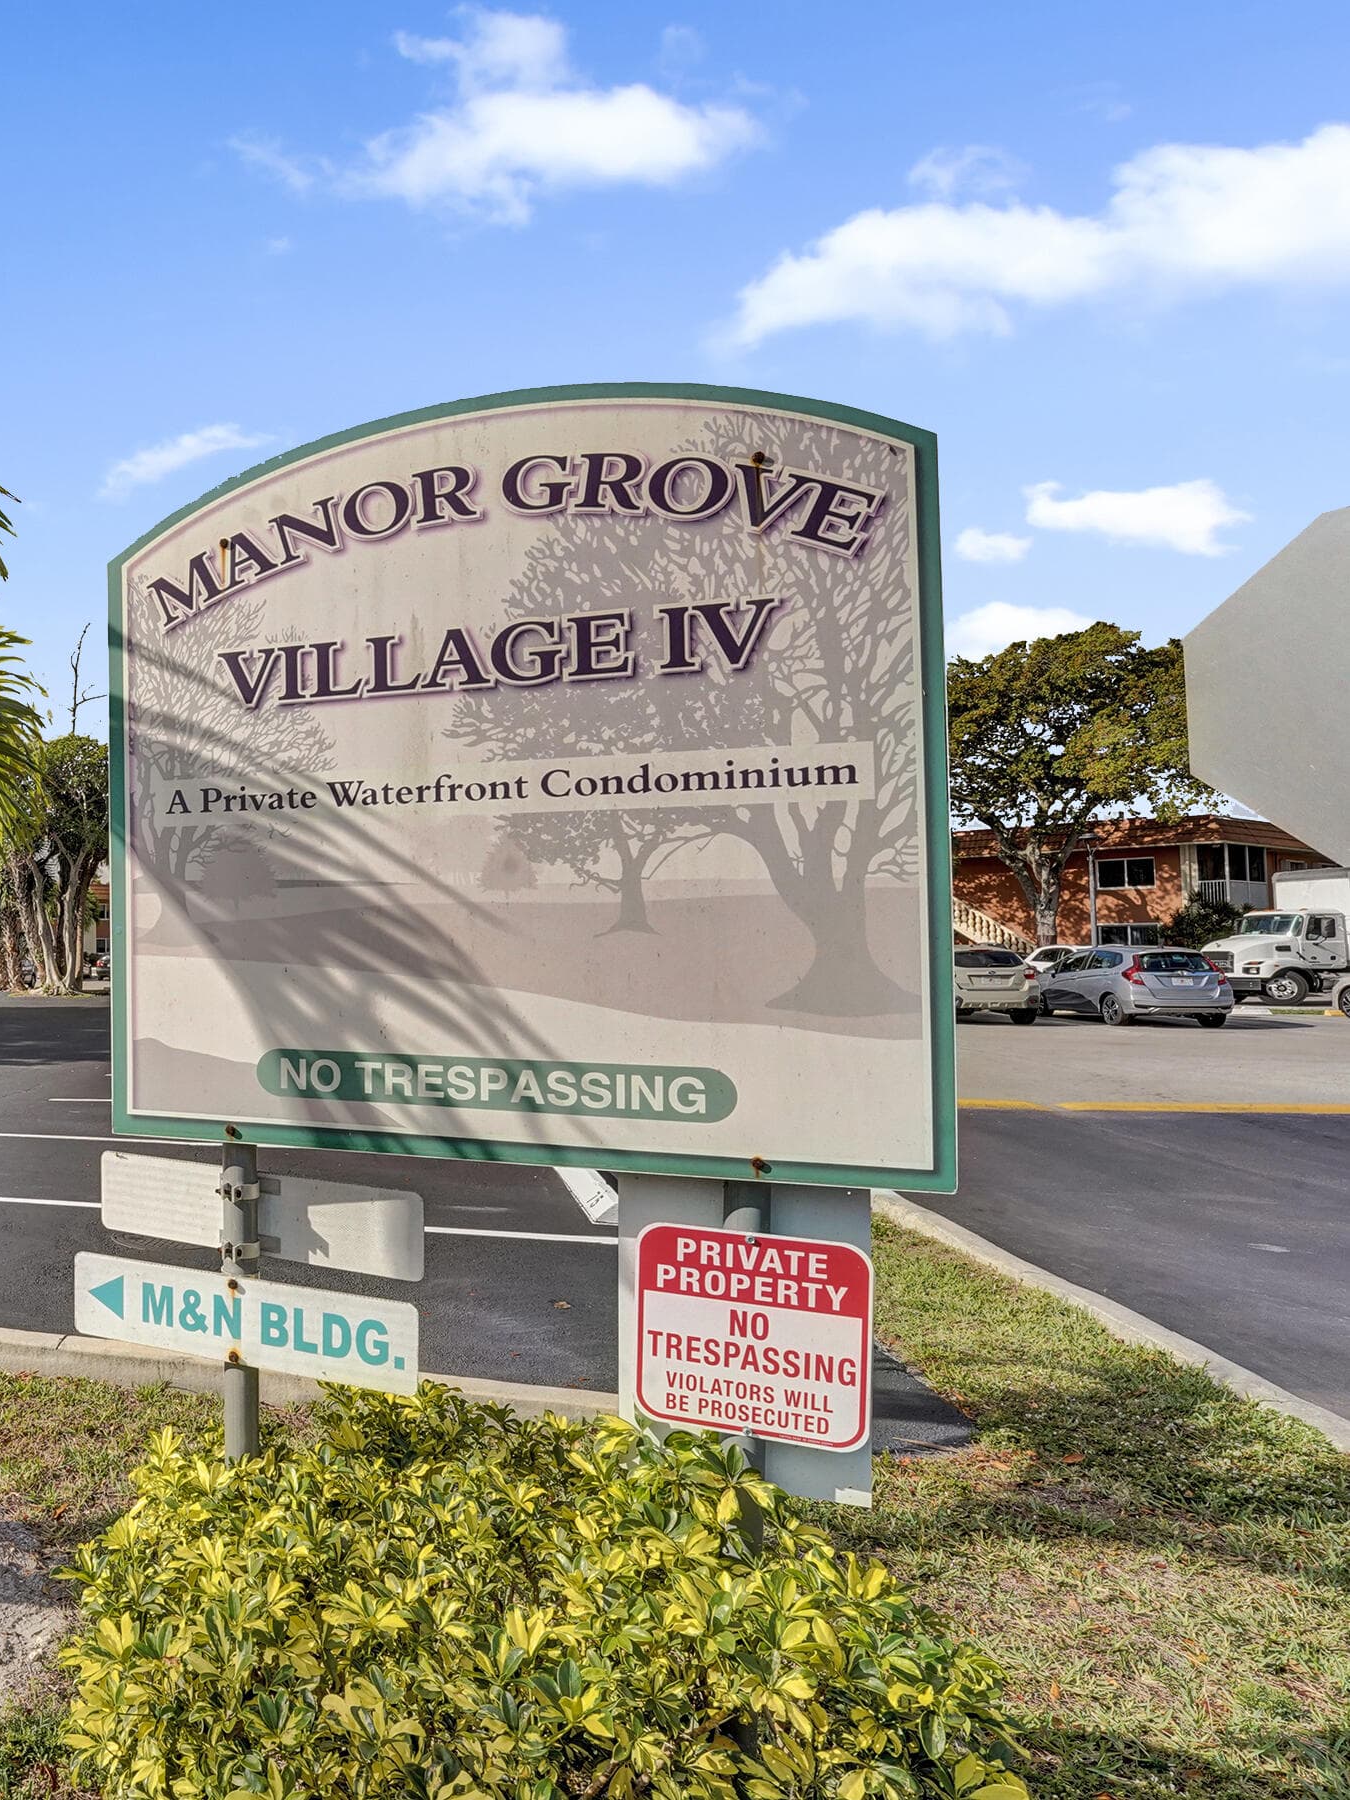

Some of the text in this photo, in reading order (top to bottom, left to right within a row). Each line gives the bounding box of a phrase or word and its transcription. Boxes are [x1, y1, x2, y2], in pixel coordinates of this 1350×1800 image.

[145, 452, 886, 630] MANOR GROVE
[217, 597, 781, 706] VILLAGE IV
[165, 756, 859, 815] A Private Waterfront Condominium
[278, 1056, 708, 1115] NO TRESPASSING
[676, 1236, 828, 1280] PRIVATE
[656, 1263, 849, 1312] PROPERTY
[141, 1281, 406, 1371] M&N BLDG.
[728, 1309, 770, 1342] NO
[647, 1329, 857, 1387] TRESPASSING
[665, 1393, 830, 1436] BE PROSECUTED
[666, 1370, 834, 1414] VIOLATORS WILL
